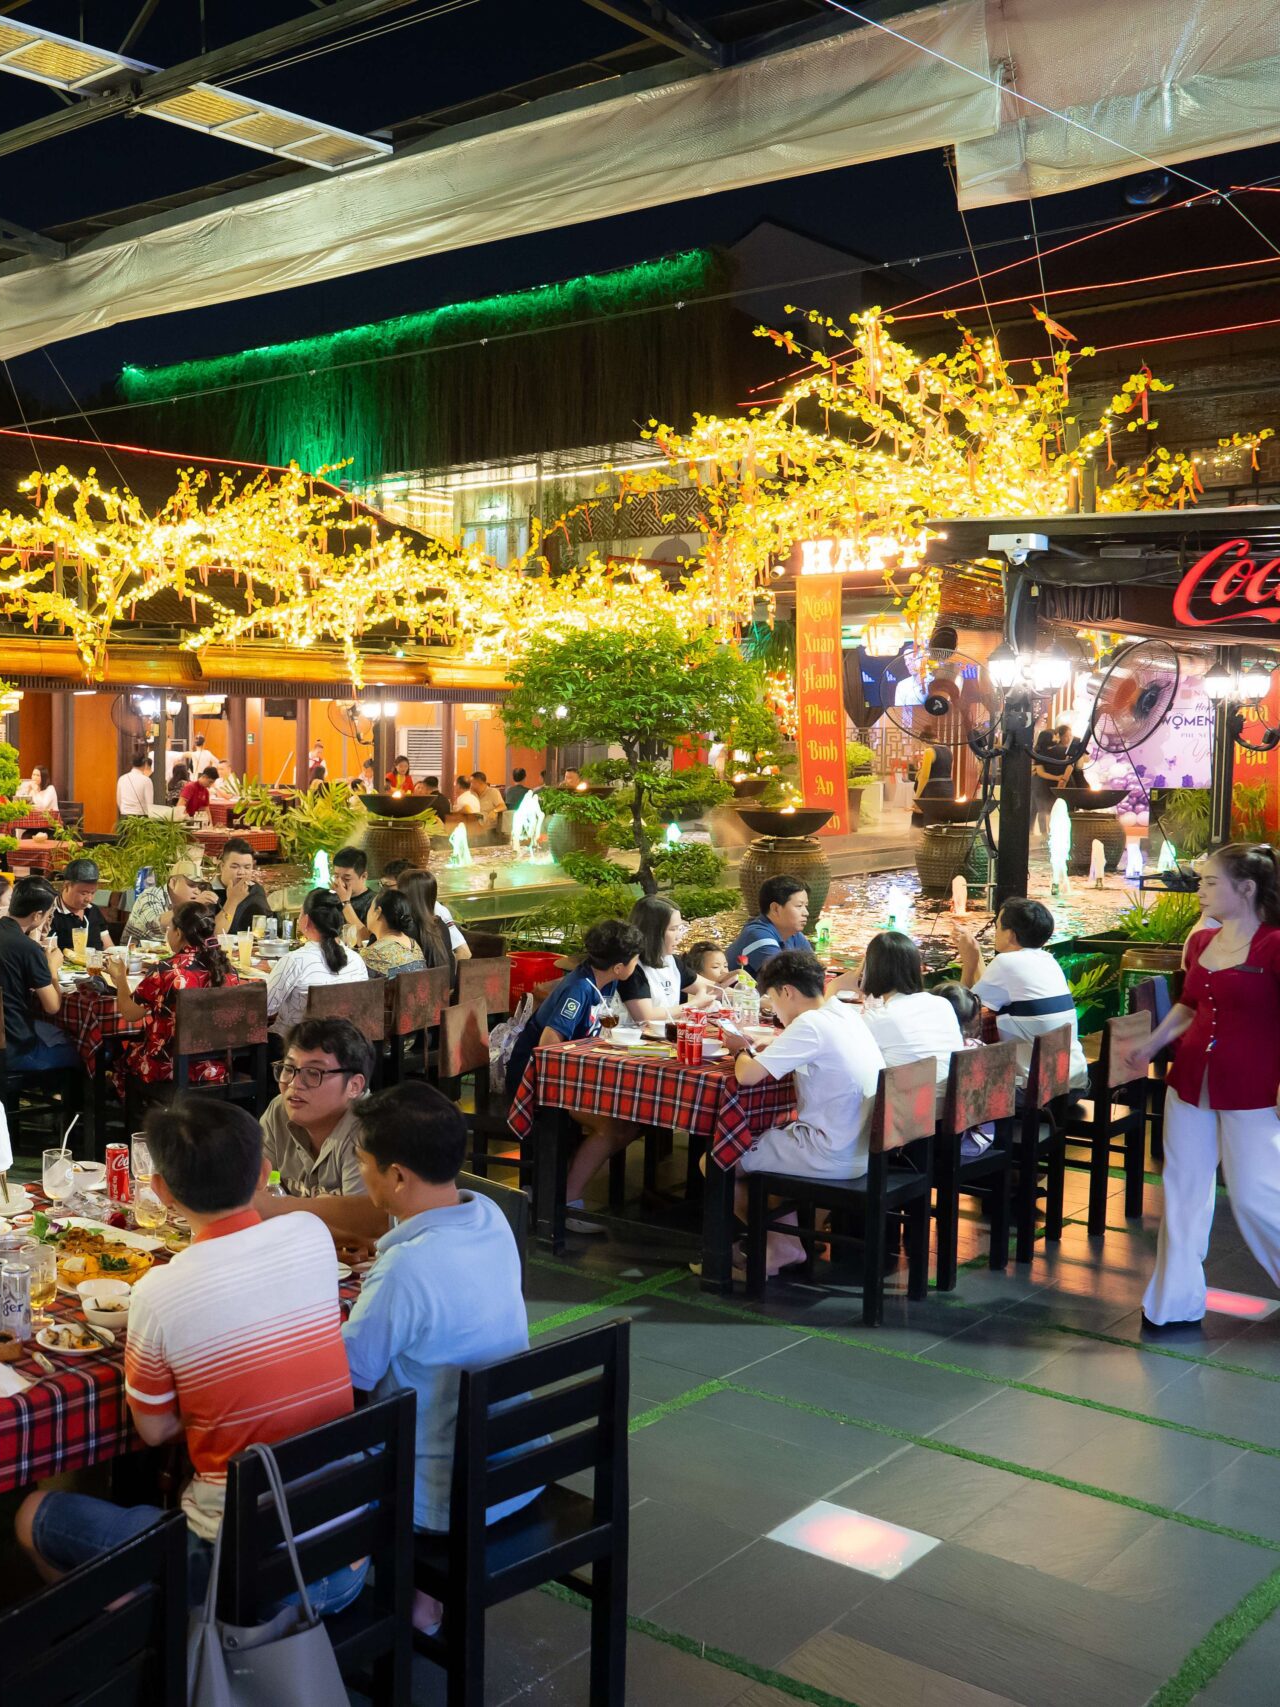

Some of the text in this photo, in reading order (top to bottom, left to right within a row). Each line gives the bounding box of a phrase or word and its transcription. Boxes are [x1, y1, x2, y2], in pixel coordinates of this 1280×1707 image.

[1172, 538, 1280, 627] Coc
[802, 663, 837, 693] Hạnh
[805, 703, 838, 727] Phúc
[814, 774, 834, 796] An
